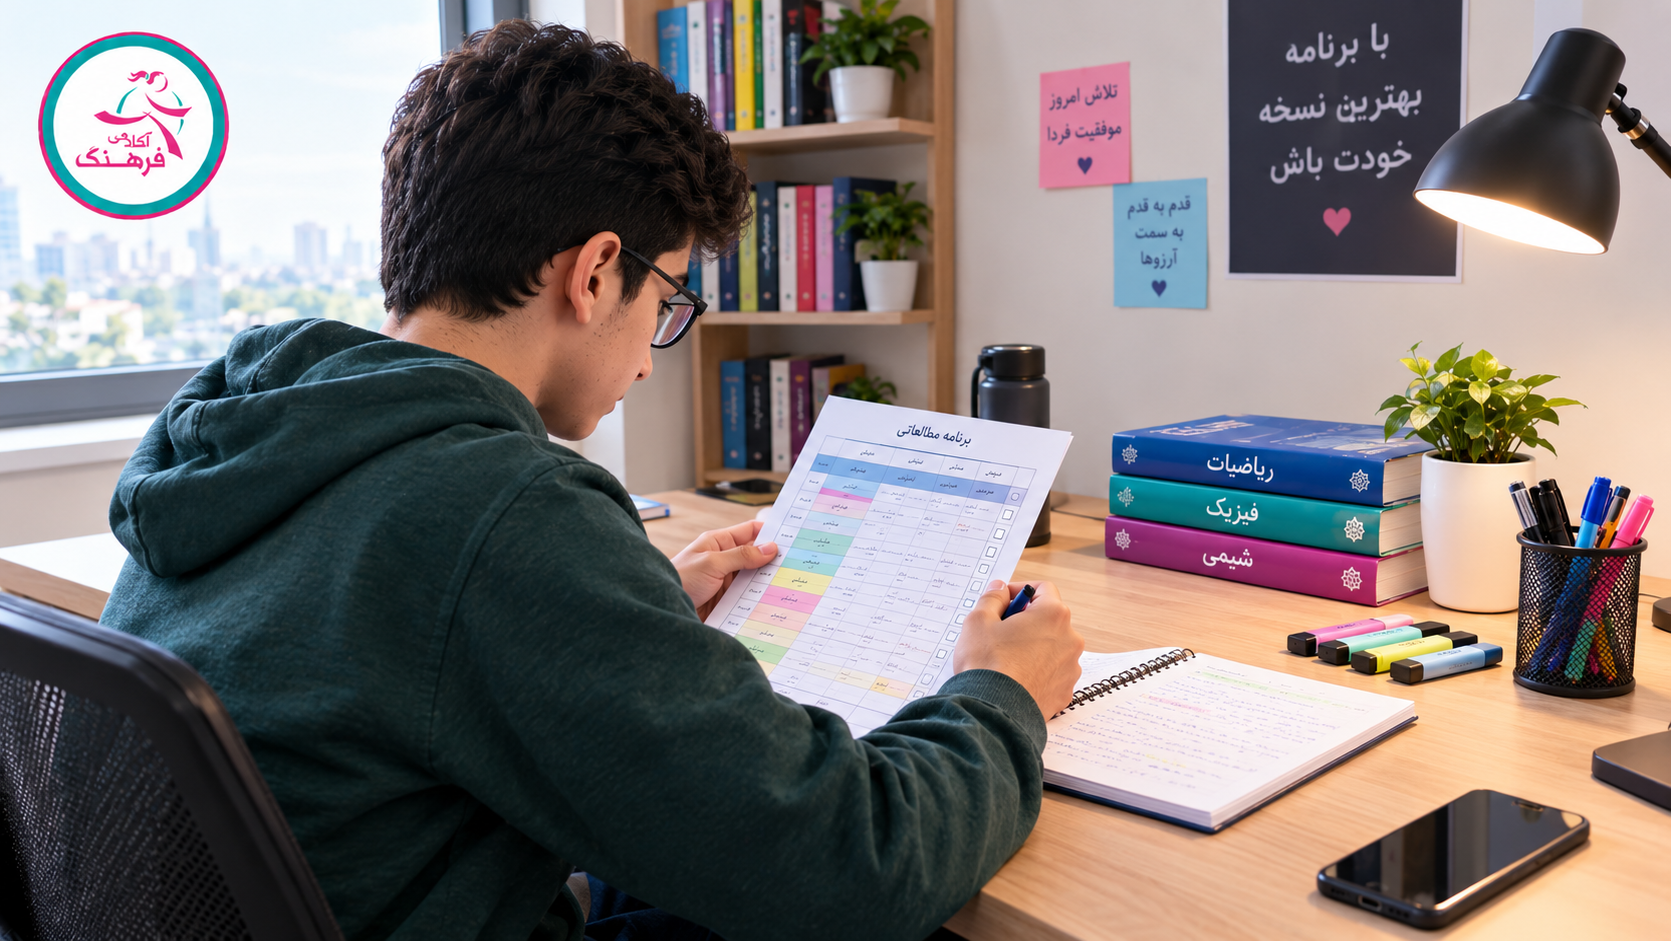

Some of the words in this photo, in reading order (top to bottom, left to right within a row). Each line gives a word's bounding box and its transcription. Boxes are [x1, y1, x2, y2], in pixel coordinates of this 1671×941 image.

[1285, 31, 1359, 68] برنامه
[1370, 22, 1389, 59] با
[1049, 88, 1080, 110] امروز
[1085, 84, 1118, 106] تلاش
[1336, 85, 1422, 123] بهترین
[1259, 93, 1327, 124] نسخه
[1047, 124, 1070, 144] فردا
[1075, 121, 1122, 141] موفقیت
[1270, 146, 1323, 184] باش
[1333, 140, 1412, 179] خودت
[1127, 198, 1149, 219] قدم
[1153, 200, 1165, 216] به
[1169, 195, 1191, 217] قدم
[1135, 228, 1168, 239] سمت
[1172, 227, 1184, 241] به
[1140, 248, 1178, 269] آرزوها
[896, 424, 940, 441] مطالعاتی
[943, 430, 972, 448] برنامه
[1206, 453, 1274, 483] ریاضیات
[1206, 497, 1259, 525] فیزیک
[1202, 548, 1254, 570] شیمی
